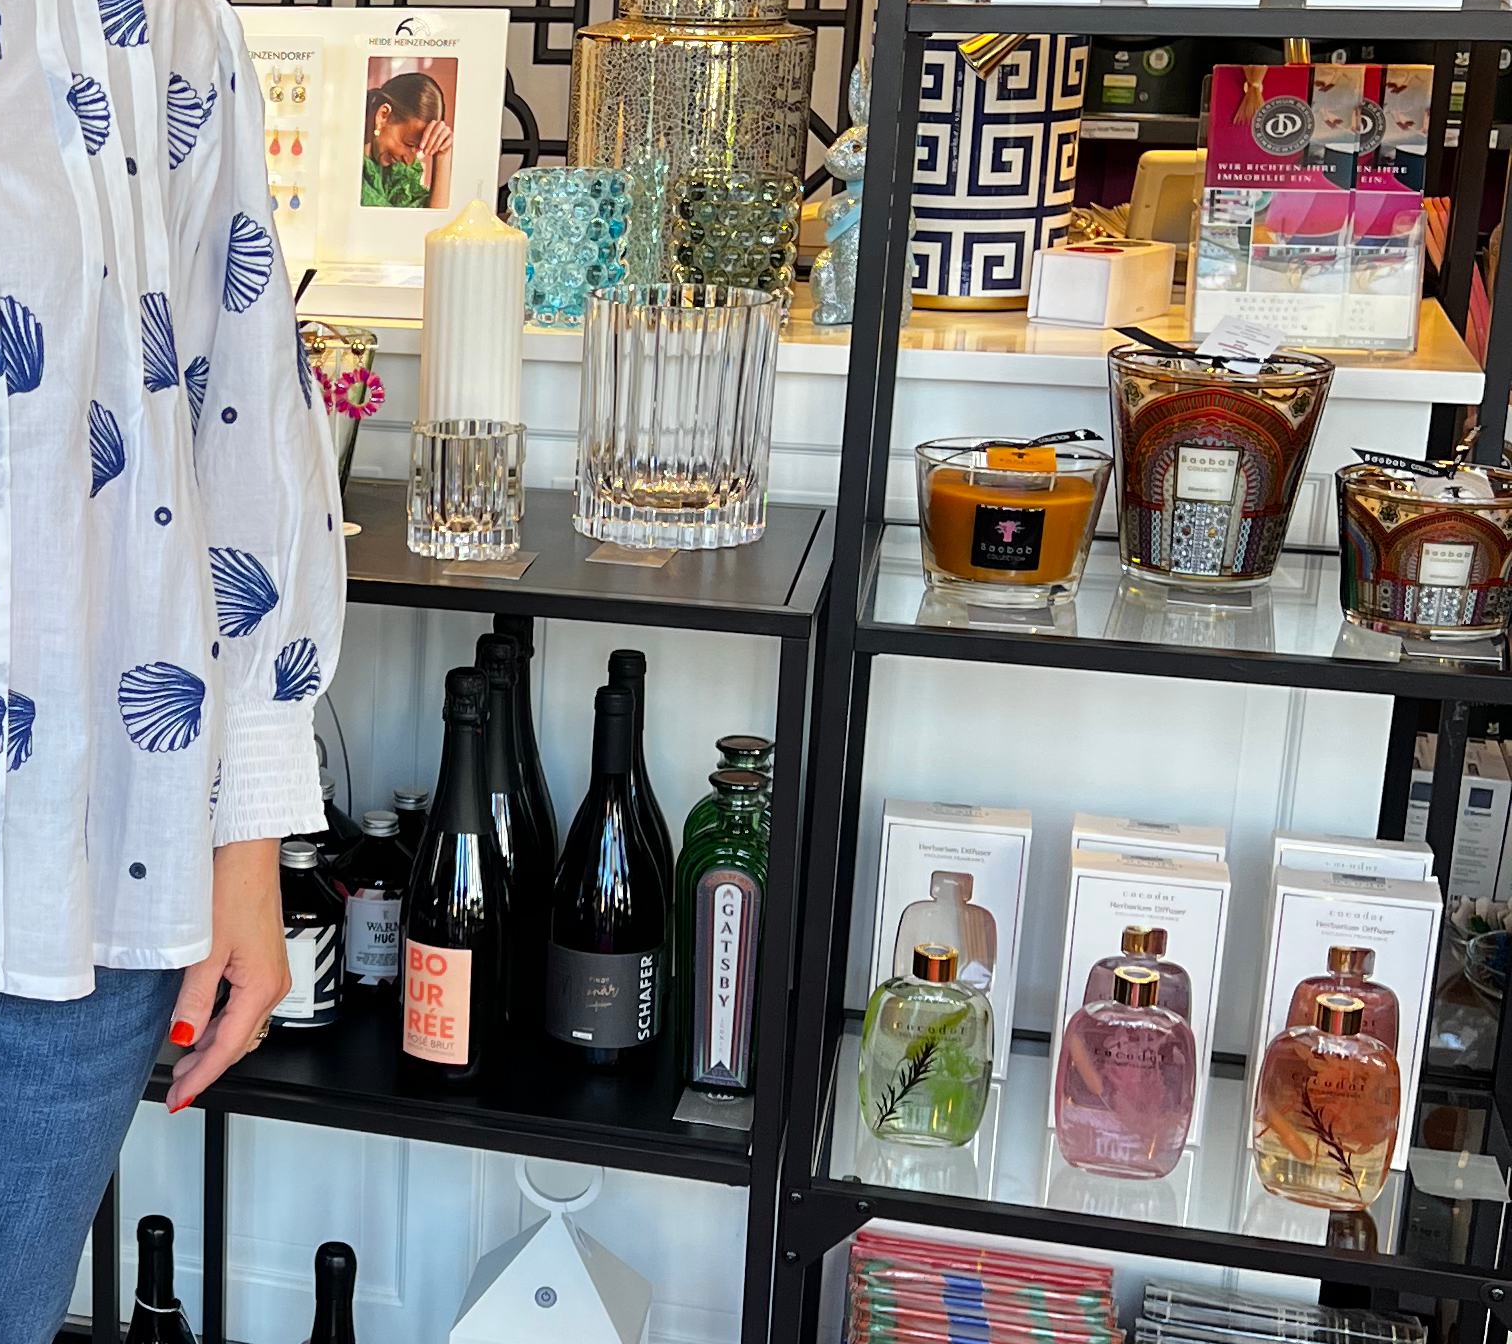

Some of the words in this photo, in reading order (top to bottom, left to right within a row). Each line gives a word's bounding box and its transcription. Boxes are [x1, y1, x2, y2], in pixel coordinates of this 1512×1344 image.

[369, 38, 392, 46] HEIDE
[1218, 163, 1241, 171] WIR
[1246, 164, 1302, 172] RICHTEN
[1307, 165, 1337, 173] IHRE
[1217, 173, 1286, 182] IMMOBILIE
[1181, 455, 1235, 467] Baobab
[1365, 454, 1406, 467] Baobab
[980, 542, 1033, 555] Baobab
[1424, 549, 1471, 559] Baobab
[374, 933, 395, 944] HUG
[409, 947, 447, 976] BO
[408, 978, 443, 1007] UR
[408, 1008, 455, 1039] RÉE
[430, 1037, 455, 1051] BRUT
